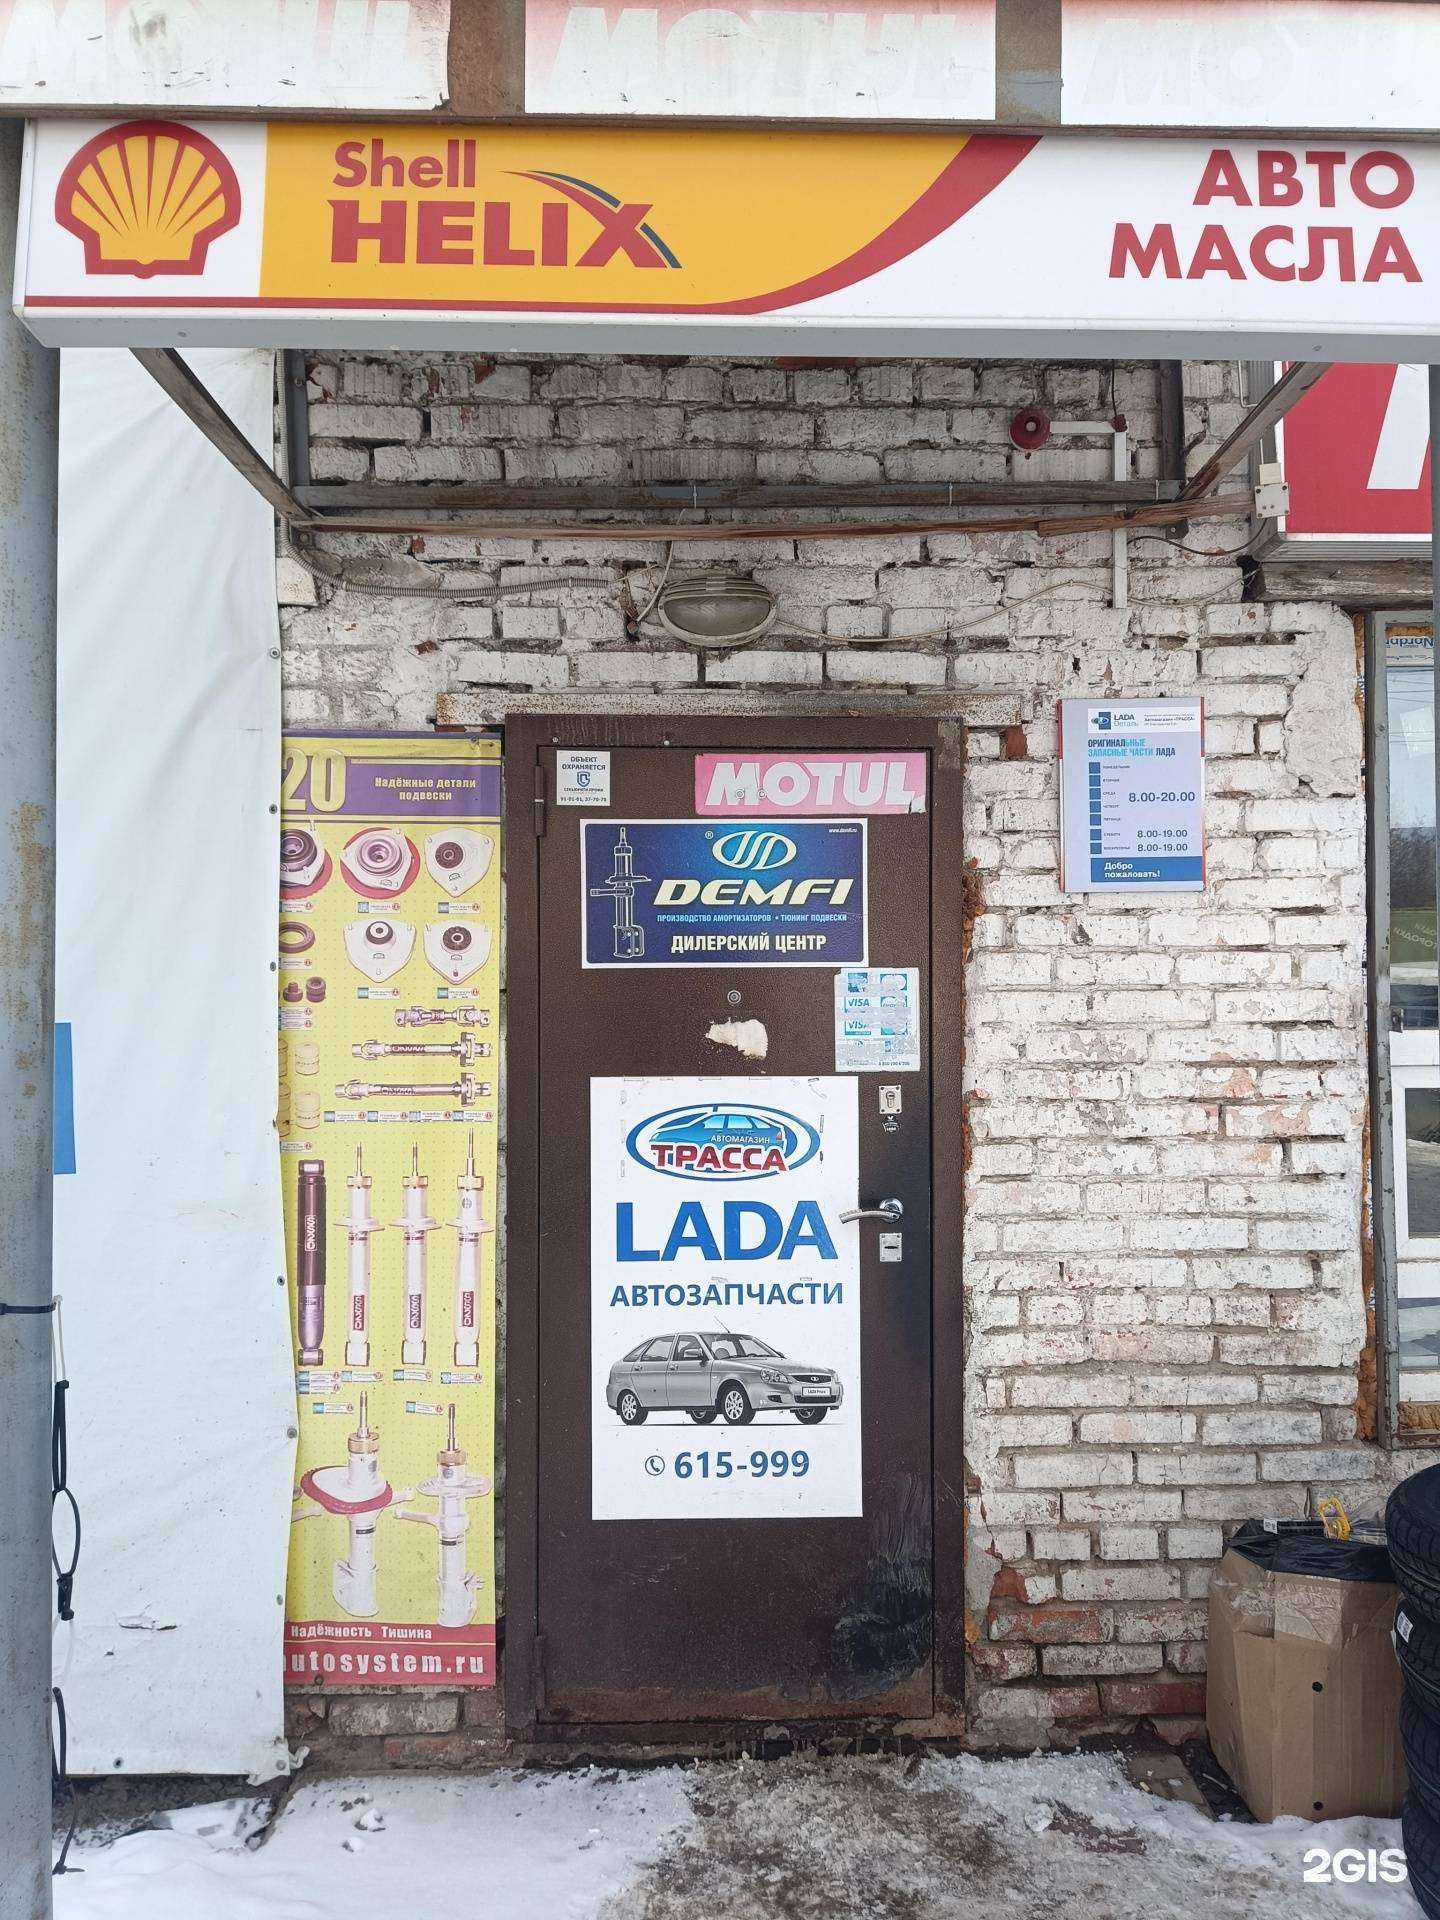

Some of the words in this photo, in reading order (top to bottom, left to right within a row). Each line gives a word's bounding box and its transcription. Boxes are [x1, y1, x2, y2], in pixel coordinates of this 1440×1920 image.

[333, 138, 476, 188] Shell
[1193, 149, 1415, 209] АВТО
[327, 199, 677, 269] HELIX
[1109, 222, 1423, 283] МАСЛА
[1087, 739, 1146, 748] ОРИГИНАЛЬНЫЕ
[1088, 748, 1128, 757] ЗАПАСНЫЕ
[1130, 748, 1153, 757] ЧАСТИ
[1155, 747, 1176, 757] ЛАДА
[374, 776, 434, 789] Надёжные
[436, 778, 476, 790] детали
[704, 761, 917, 806] MOTUL
[399, 790, 452, 801] подвески
[1128, 791, 1195, 803] 8.00-20.00
[1137, 829, 1188, 838] 8.00-19.00
[1137, 843, 1188, 852] 8.00-19.00
[1104, 862, 1133, 871] Добро
[1104, 869, 1161, 879] пожаловать!
[652, 878, 854, 906] DEMFI
[657, 914, 711, 923] ПРОИЗВОДСТВО
[713, 914, 772, 922] АМОРТИЗАТОРОВ
[781, 914, 809, 922] ТЮНИНГ
[811, 914, 847, 923] ПОДВЕСКИ
[671, 932, 770, 954] ДИЛЕРСКИЙ
[775, 934, 827, 953] ЦЕНТР
[848, 998, 870, 1007] VISA
[710, 1134, 770, 1144] АВТОМАГАЗИН
[650, 1144, 787, 1172] ТРАССА
[616, 1200, 839, 1262] LADA
[609, 1282, 843, 1307] АВТОЗАПЧАСТИ
[674, 1451, 810, 1479] 615-999
[291, 1624, 372, 1638] Надёжность
[381, 1625, 432, 1639] Тишина
